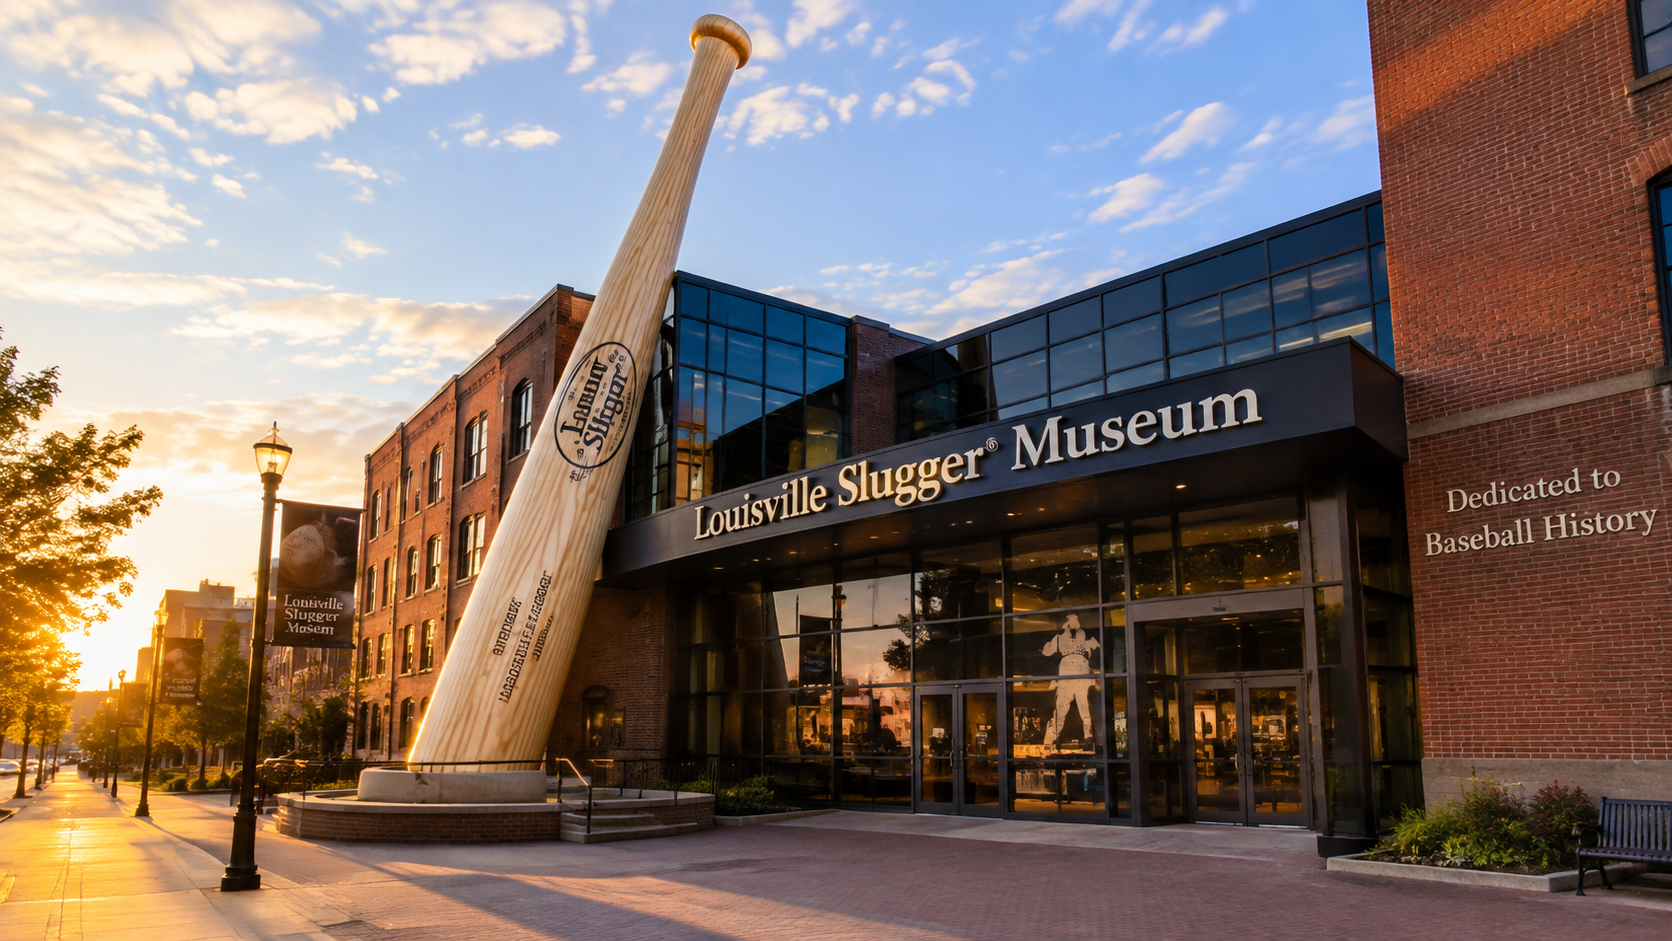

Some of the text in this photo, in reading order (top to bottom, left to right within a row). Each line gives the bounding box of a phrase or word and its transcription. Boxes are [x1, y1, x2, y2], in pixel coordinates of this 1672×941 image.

[693, 476, 828, 541] Louisville
[1010, 387, 1263, 472] Museum
[1446, 467, 1622, 513] Dedicated to
[1425, 508, 1658, 557] Baseball History
